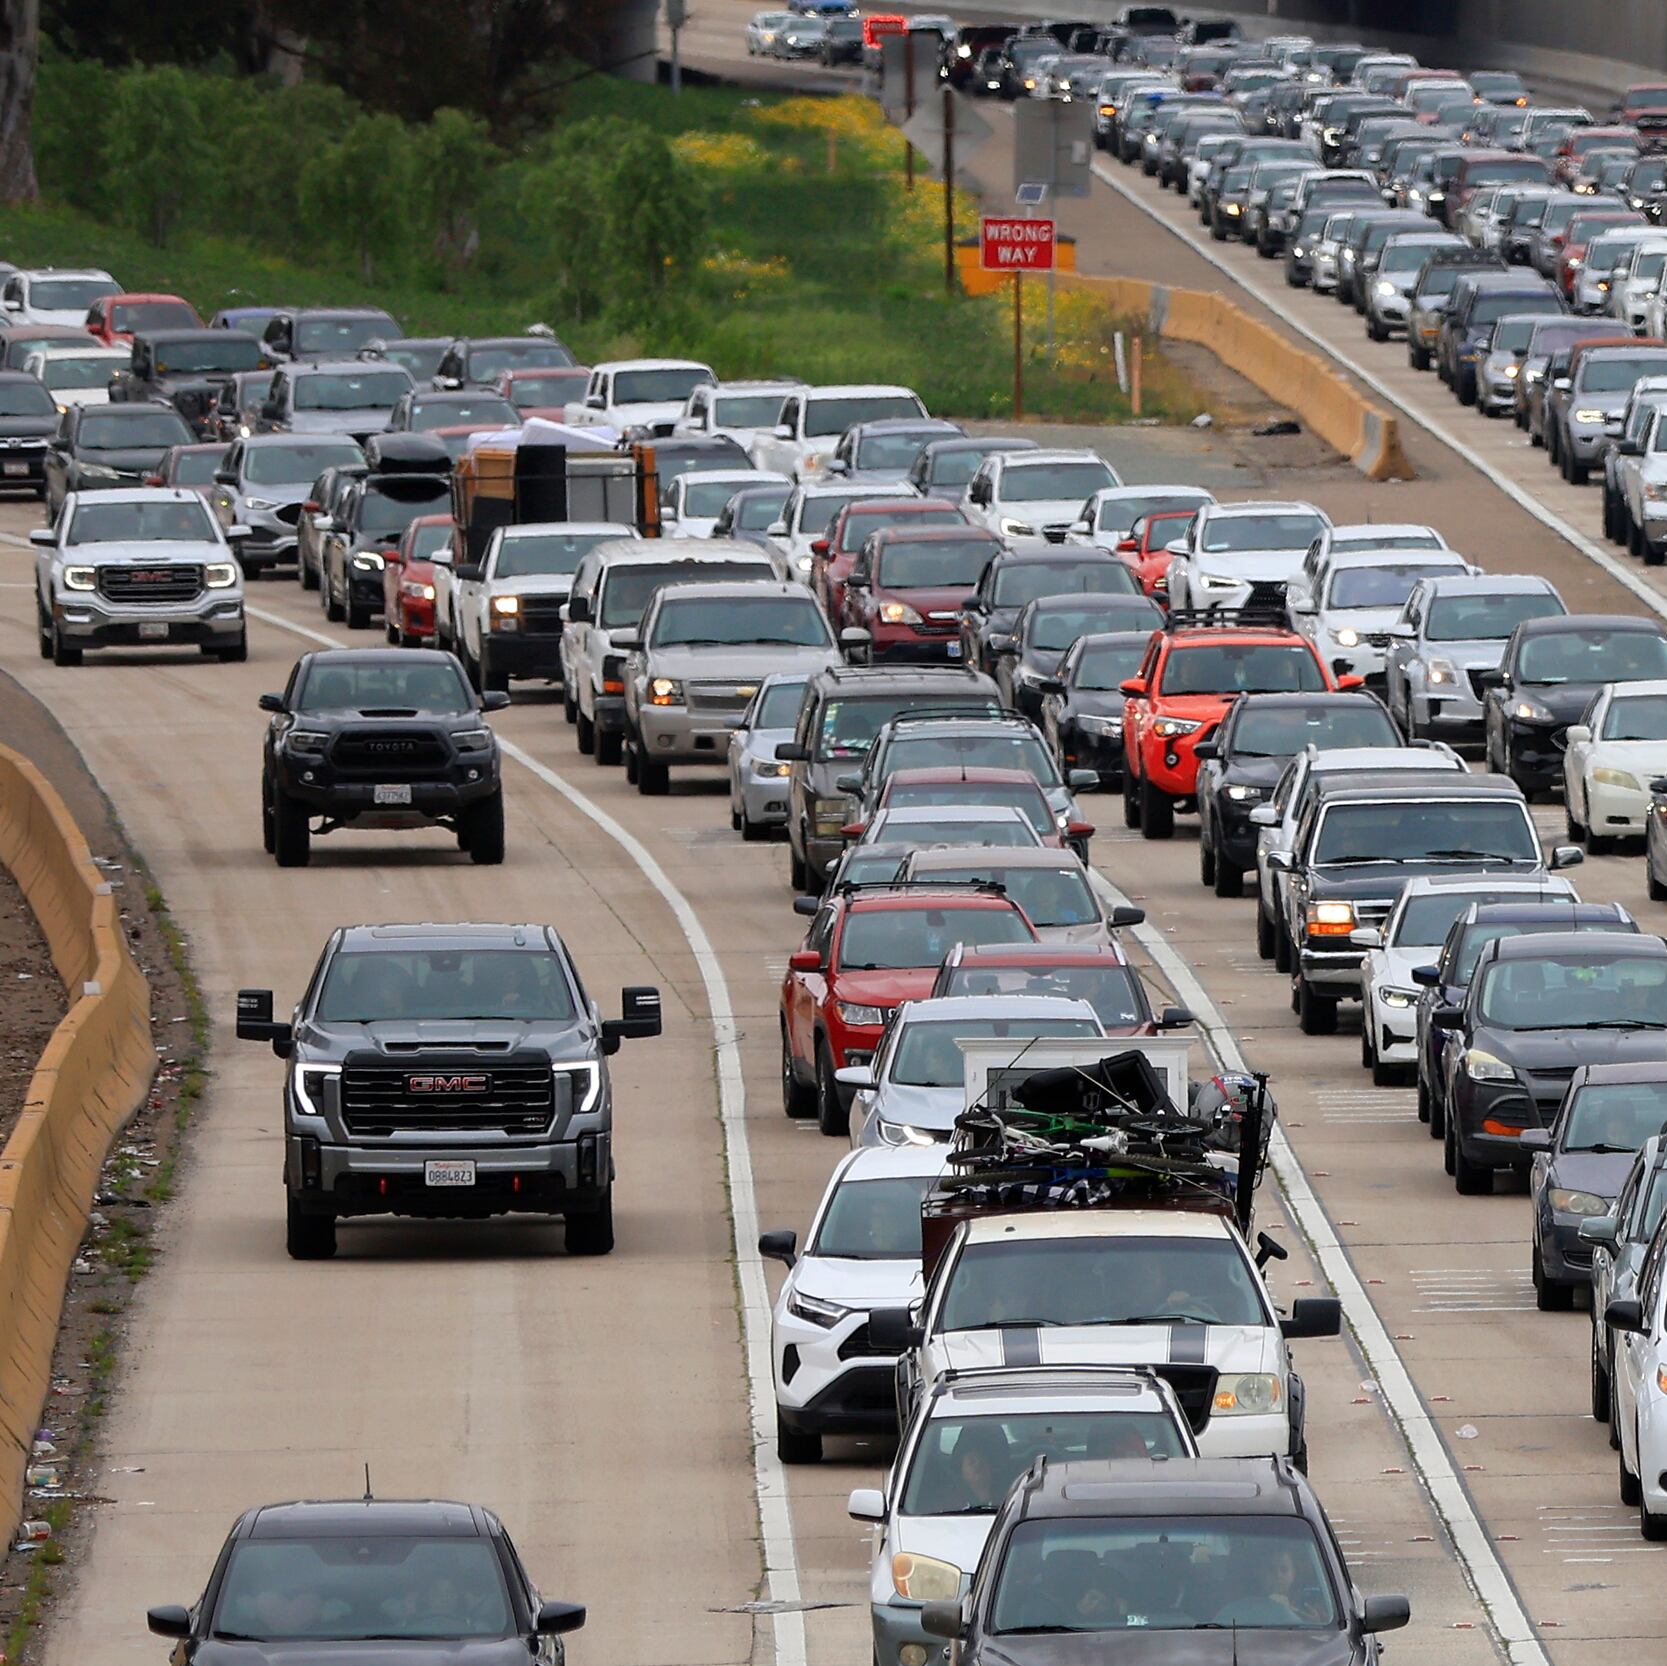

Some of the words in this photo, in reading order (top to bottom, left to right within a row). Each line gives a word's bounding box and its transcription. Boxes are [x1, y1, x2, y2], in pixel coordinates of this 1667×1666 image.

[985, 223, 1052, 242] WRONG
[997, 245, 1038, 264] WAY
[131, 570, 172, 582] GMC
[369, 742, 415, 752] TOYOTA
[409, 1076, 488, 1092] GMC
